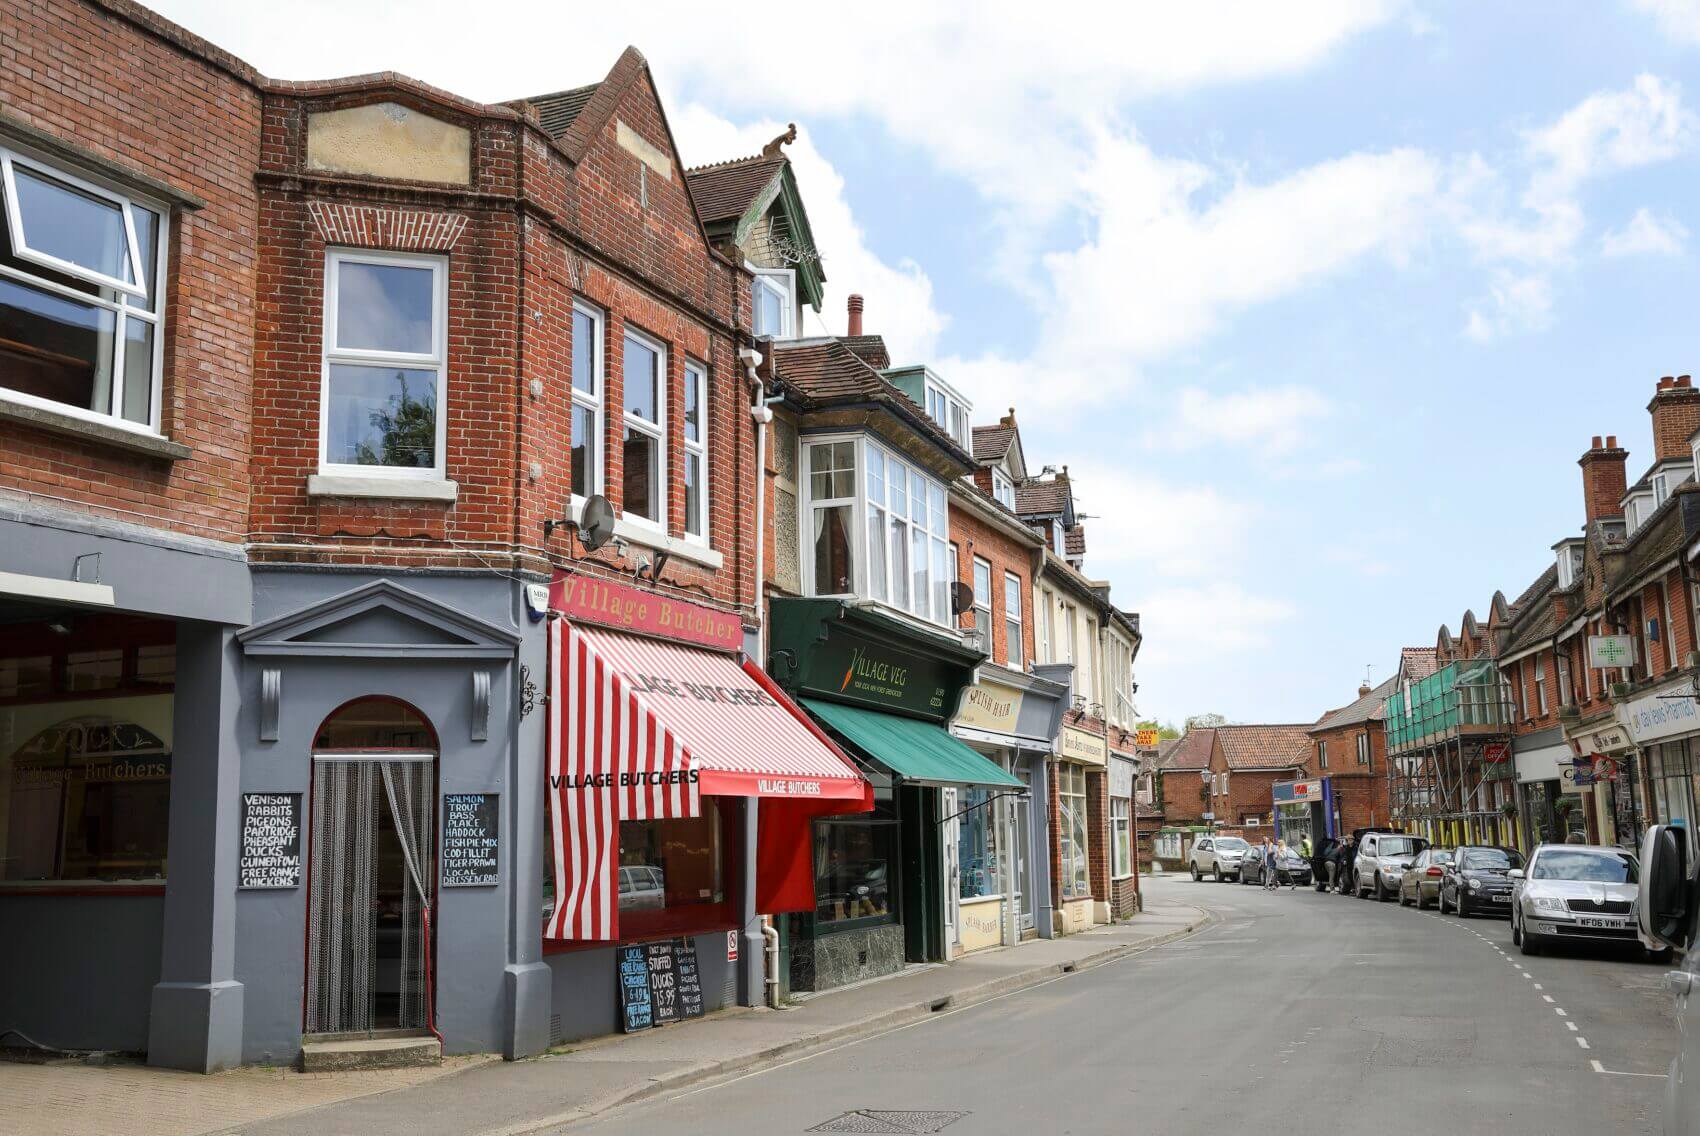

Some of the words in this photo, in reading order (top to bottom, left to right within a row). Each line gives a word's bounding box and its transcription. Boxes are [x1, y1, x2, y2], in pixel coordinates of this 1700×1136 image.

[562, 578, 648, 625] Village
[658, 601, 735, 641] Butcher
[850, 646, 889, 681] VILLAGE
[890, 666, 907, 686] VEG
[680, 681, 778, 708] BUTCHERS
[85, 760, 166, 780] Butchers
[550, 773, 614, 789] VILLAGE
[620, 769, 699, 787] BUTCHERS
[758, 779, 786, 794] VILLAGE
[788, 780, 821, 795] BUTCHERS
[244, 794, 292, 805] VENISON
[446, 795, 485, 804] SALMON
[247, 805, 294, 816] RABBITS
[448, 803, 480, 812] TROUT
[449, 811, 475, 820] BASS
[246, 816, 292, 827] PIGEONS
[448, 818, 480, 828] PLAICE
[244, 825, 298, 837] PARTRIDGE
[445, 828, 486, 837] HADDOCK
[243, 836, 295, 846] PHEASANT
[445, 838, 466, 848] FISH
[481, 838, 498, 847] MIX
[245, 846, 284, 856] DUCKS
[241, 867, 268, 878] FREE
[269, 866, 300, 878] RANGE
[446, 868, 477, 877] LOCAL
[243, 876, 294, 887] CHICKENS
[1605, 919, 1622, 928] VWH
[648, 955, 672, 970] STUFFED
[651, 973, 674, 989] DUCKS
